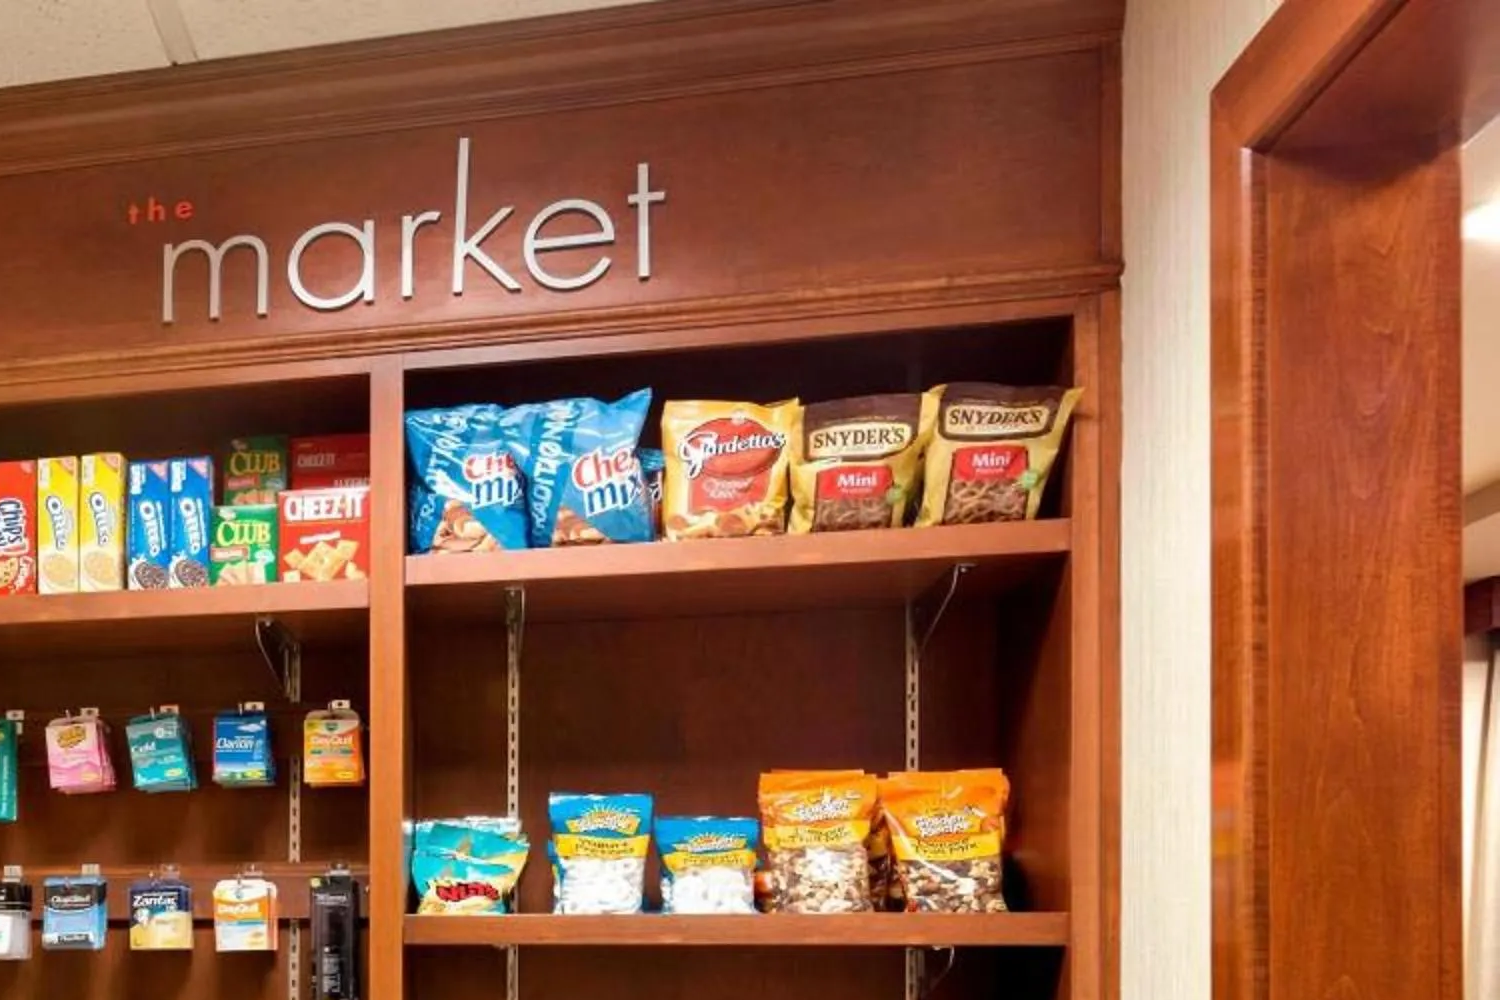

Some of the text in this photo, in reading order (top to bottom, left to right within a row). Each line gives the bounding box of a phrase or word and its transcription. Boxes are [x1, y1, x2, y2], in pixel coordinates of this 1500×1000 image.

[128, 196, 193, 225] the
[162, 137, 666, 324] market
[950, 408, 1043, 425] SNYDER'S
[813, 427, 905, 449] SNYDER'S
[229, 451, 280, 475] CLUB
[972, 452, 1011, 468] Mini
[837, 472, 877, 487] Mini
[216, 521, 271, 546] CLUB
